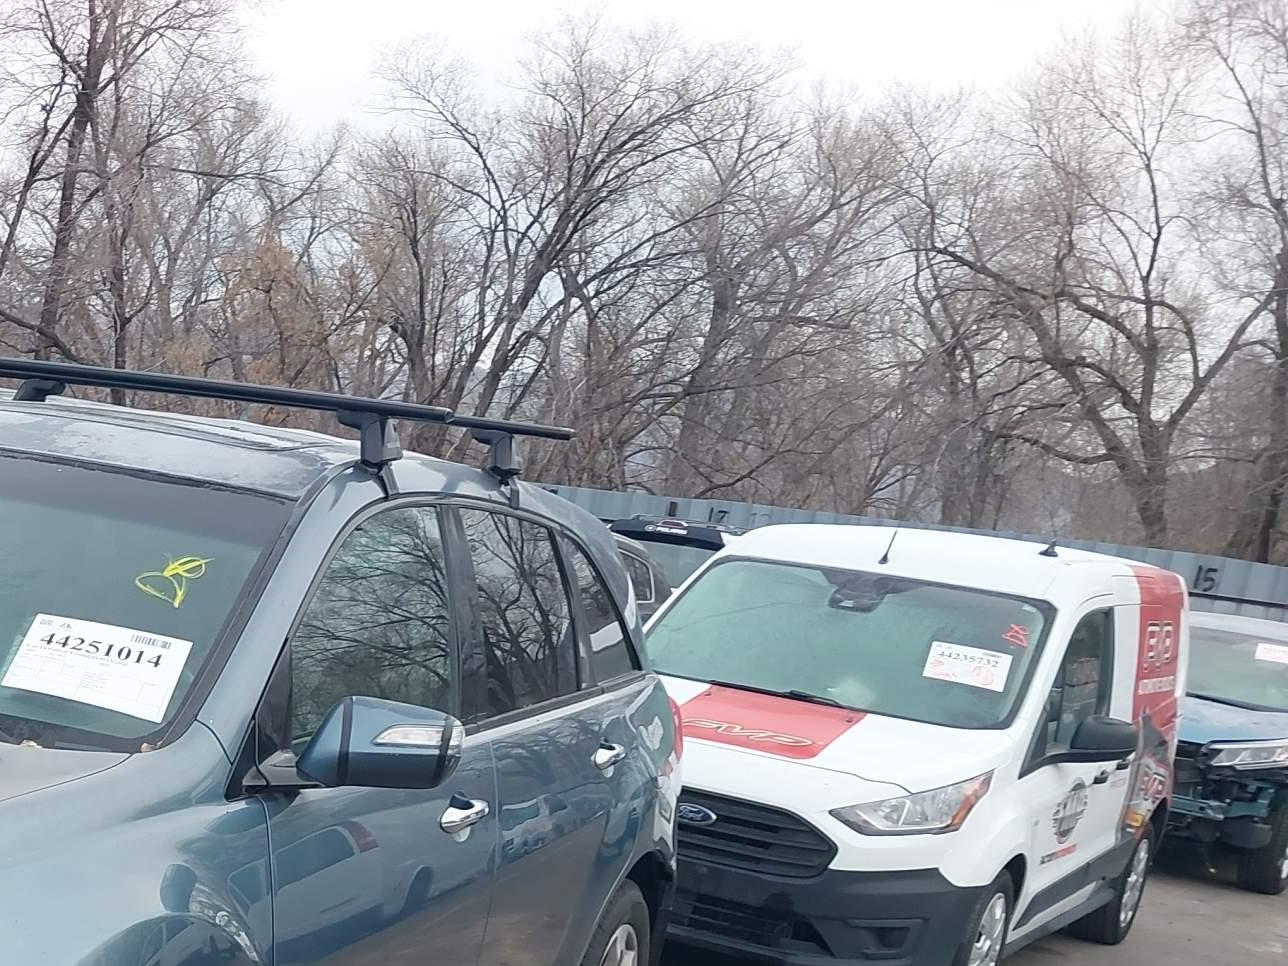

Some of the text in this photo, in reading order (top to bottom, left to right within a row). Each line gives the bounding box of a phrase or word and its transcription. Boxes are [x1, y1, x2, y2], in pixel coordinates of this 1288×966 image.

[1193, 564, 1219, 592] 15
[39, 632, 164, 668] 44251014
[936, 650, 1000, 668] 44235732
[679, 805, 705, 818] Ford
